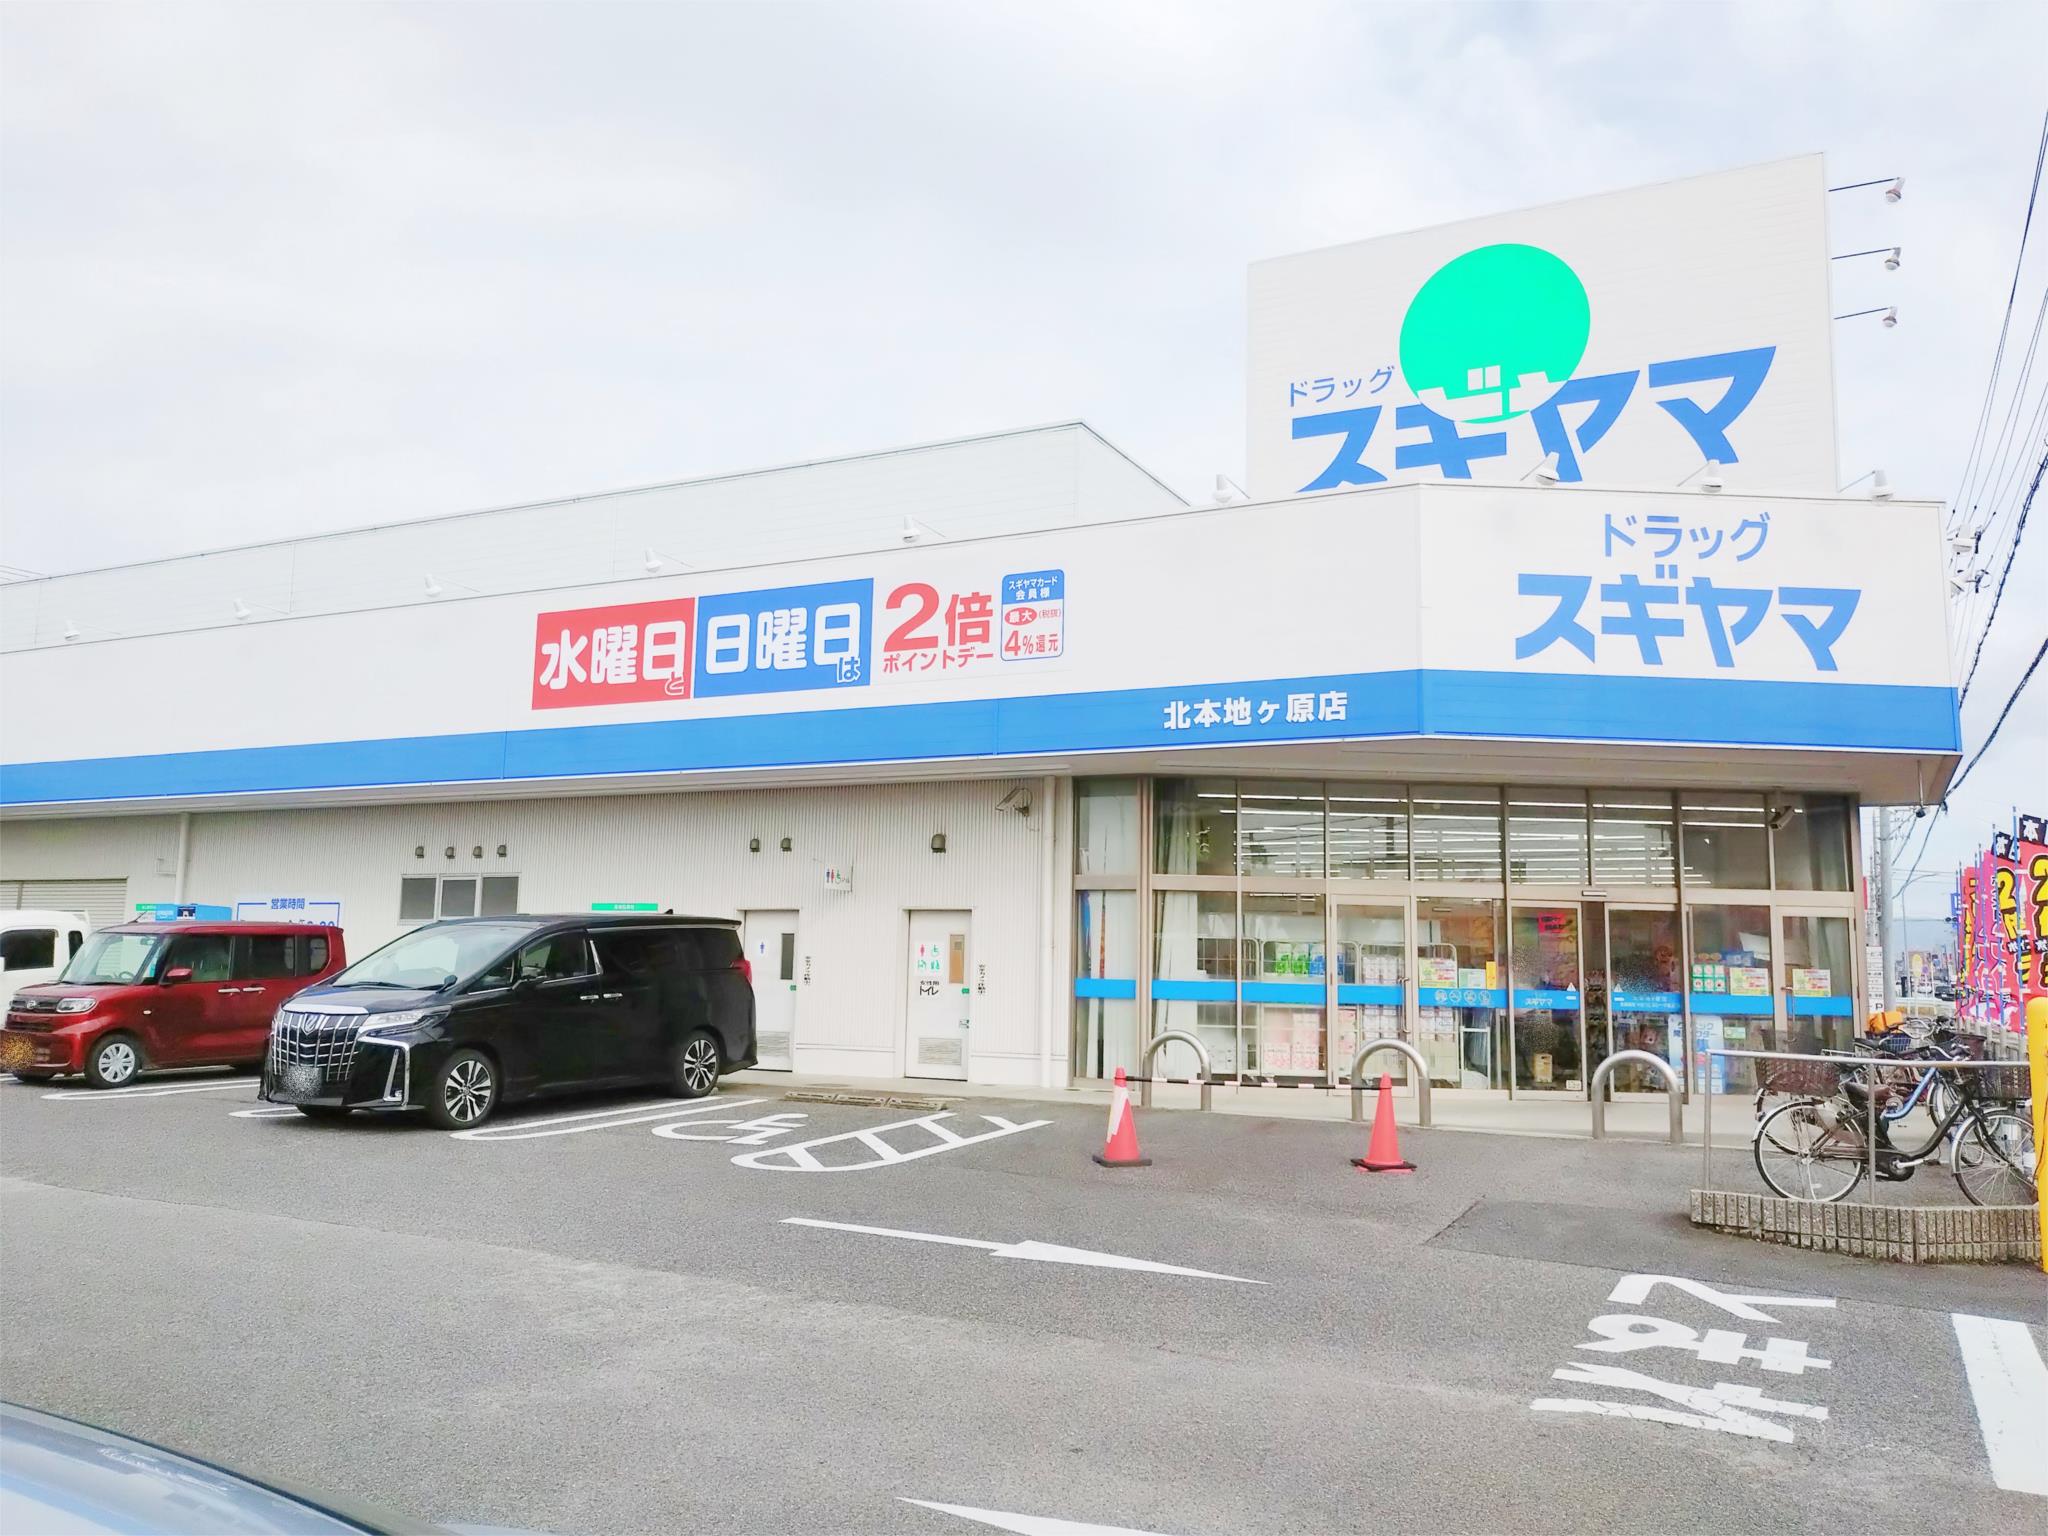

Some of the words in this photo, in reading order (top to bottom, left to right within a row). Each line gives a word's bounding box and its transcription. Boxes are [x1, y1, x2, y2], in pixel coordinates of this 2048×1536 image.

[1288, 365, 1395, 407] ドラッグ
[1292, 346, 1777, 492] スギヤマ
[1602, 511, 1770, 562] ドラッグ
[1008, 576, 1058, 590] スギヤマカード
[1015, 588, 1051, 601] 会員様
[883, 582, 994, 652] 2倍
[1008, 609, 1033, 623] 最大
[1514, 564, 1862, 671] スギヤマ
[1004, 630, 1059, 657] 4%還元
[883, 646, 994, 674] ポイントデー
[270, 898, 306, 911] 営業時間
[919, 985, 939, 996] トイレ
